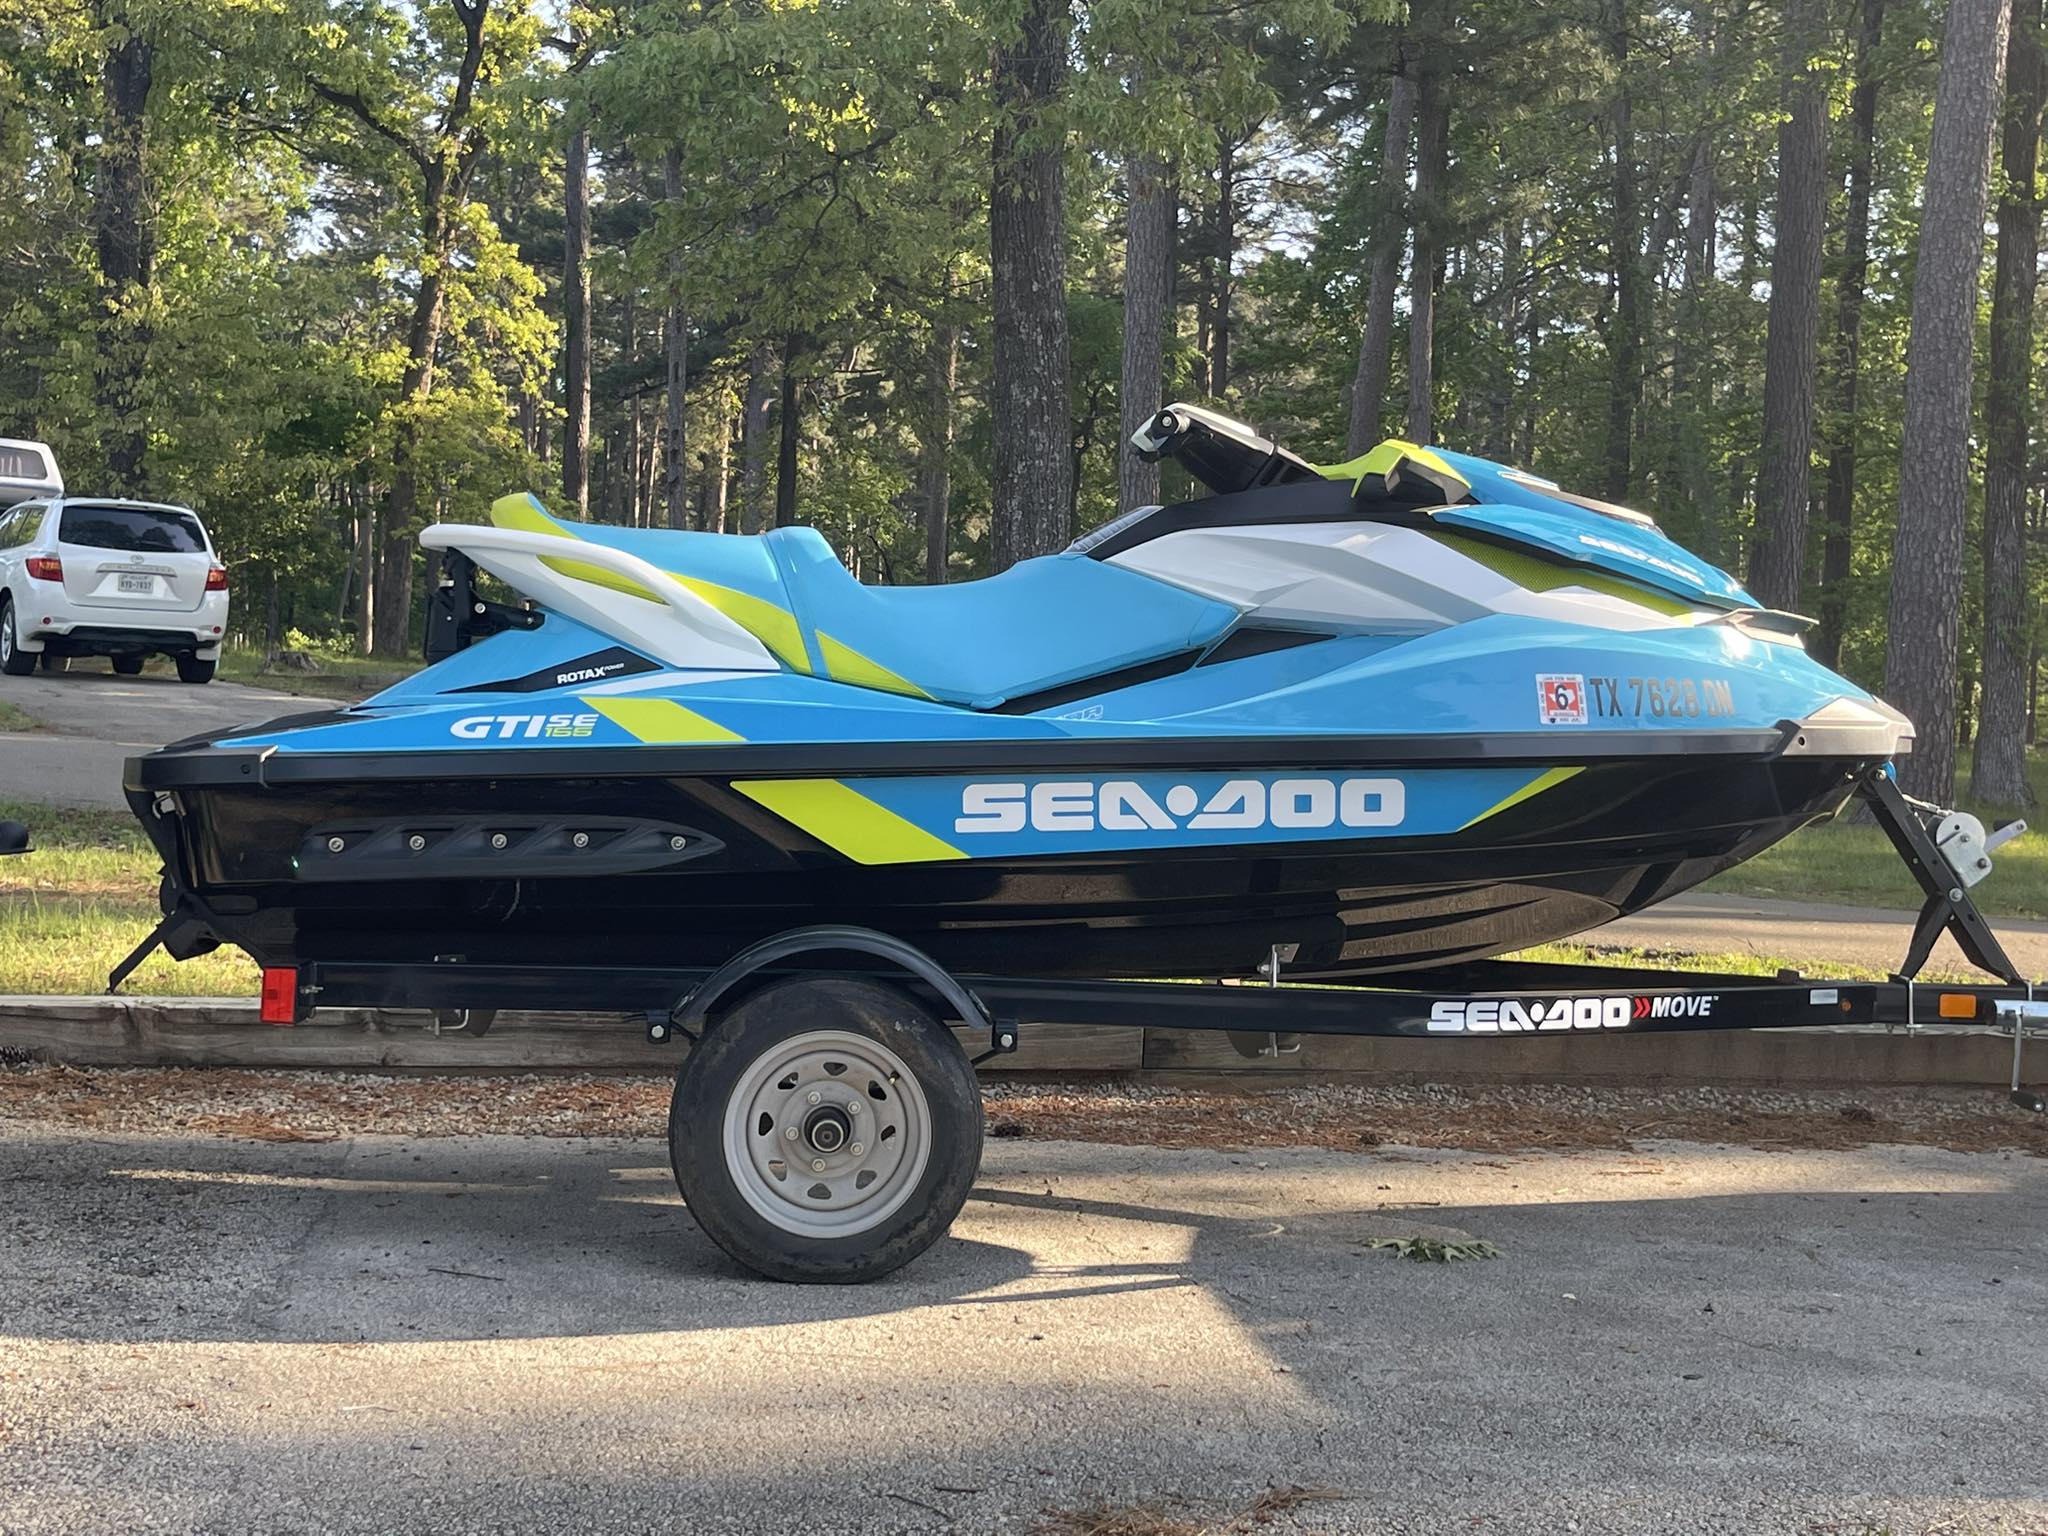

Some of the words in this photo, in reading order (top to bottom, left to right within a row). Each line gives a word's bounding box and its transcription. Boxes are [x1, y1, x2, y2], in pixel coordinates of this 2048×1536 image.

[556, 666, 606, 685] ROTAX
[604, 662, 625, 671] POWER
[1555, 684, 1569, 710] 6
[1589, 677, 1624, 717] TX
[1627, 677, 1701, 718] 7628
[450, 714, 547, 739] GTI
[546, 713, 600, 727] SE
